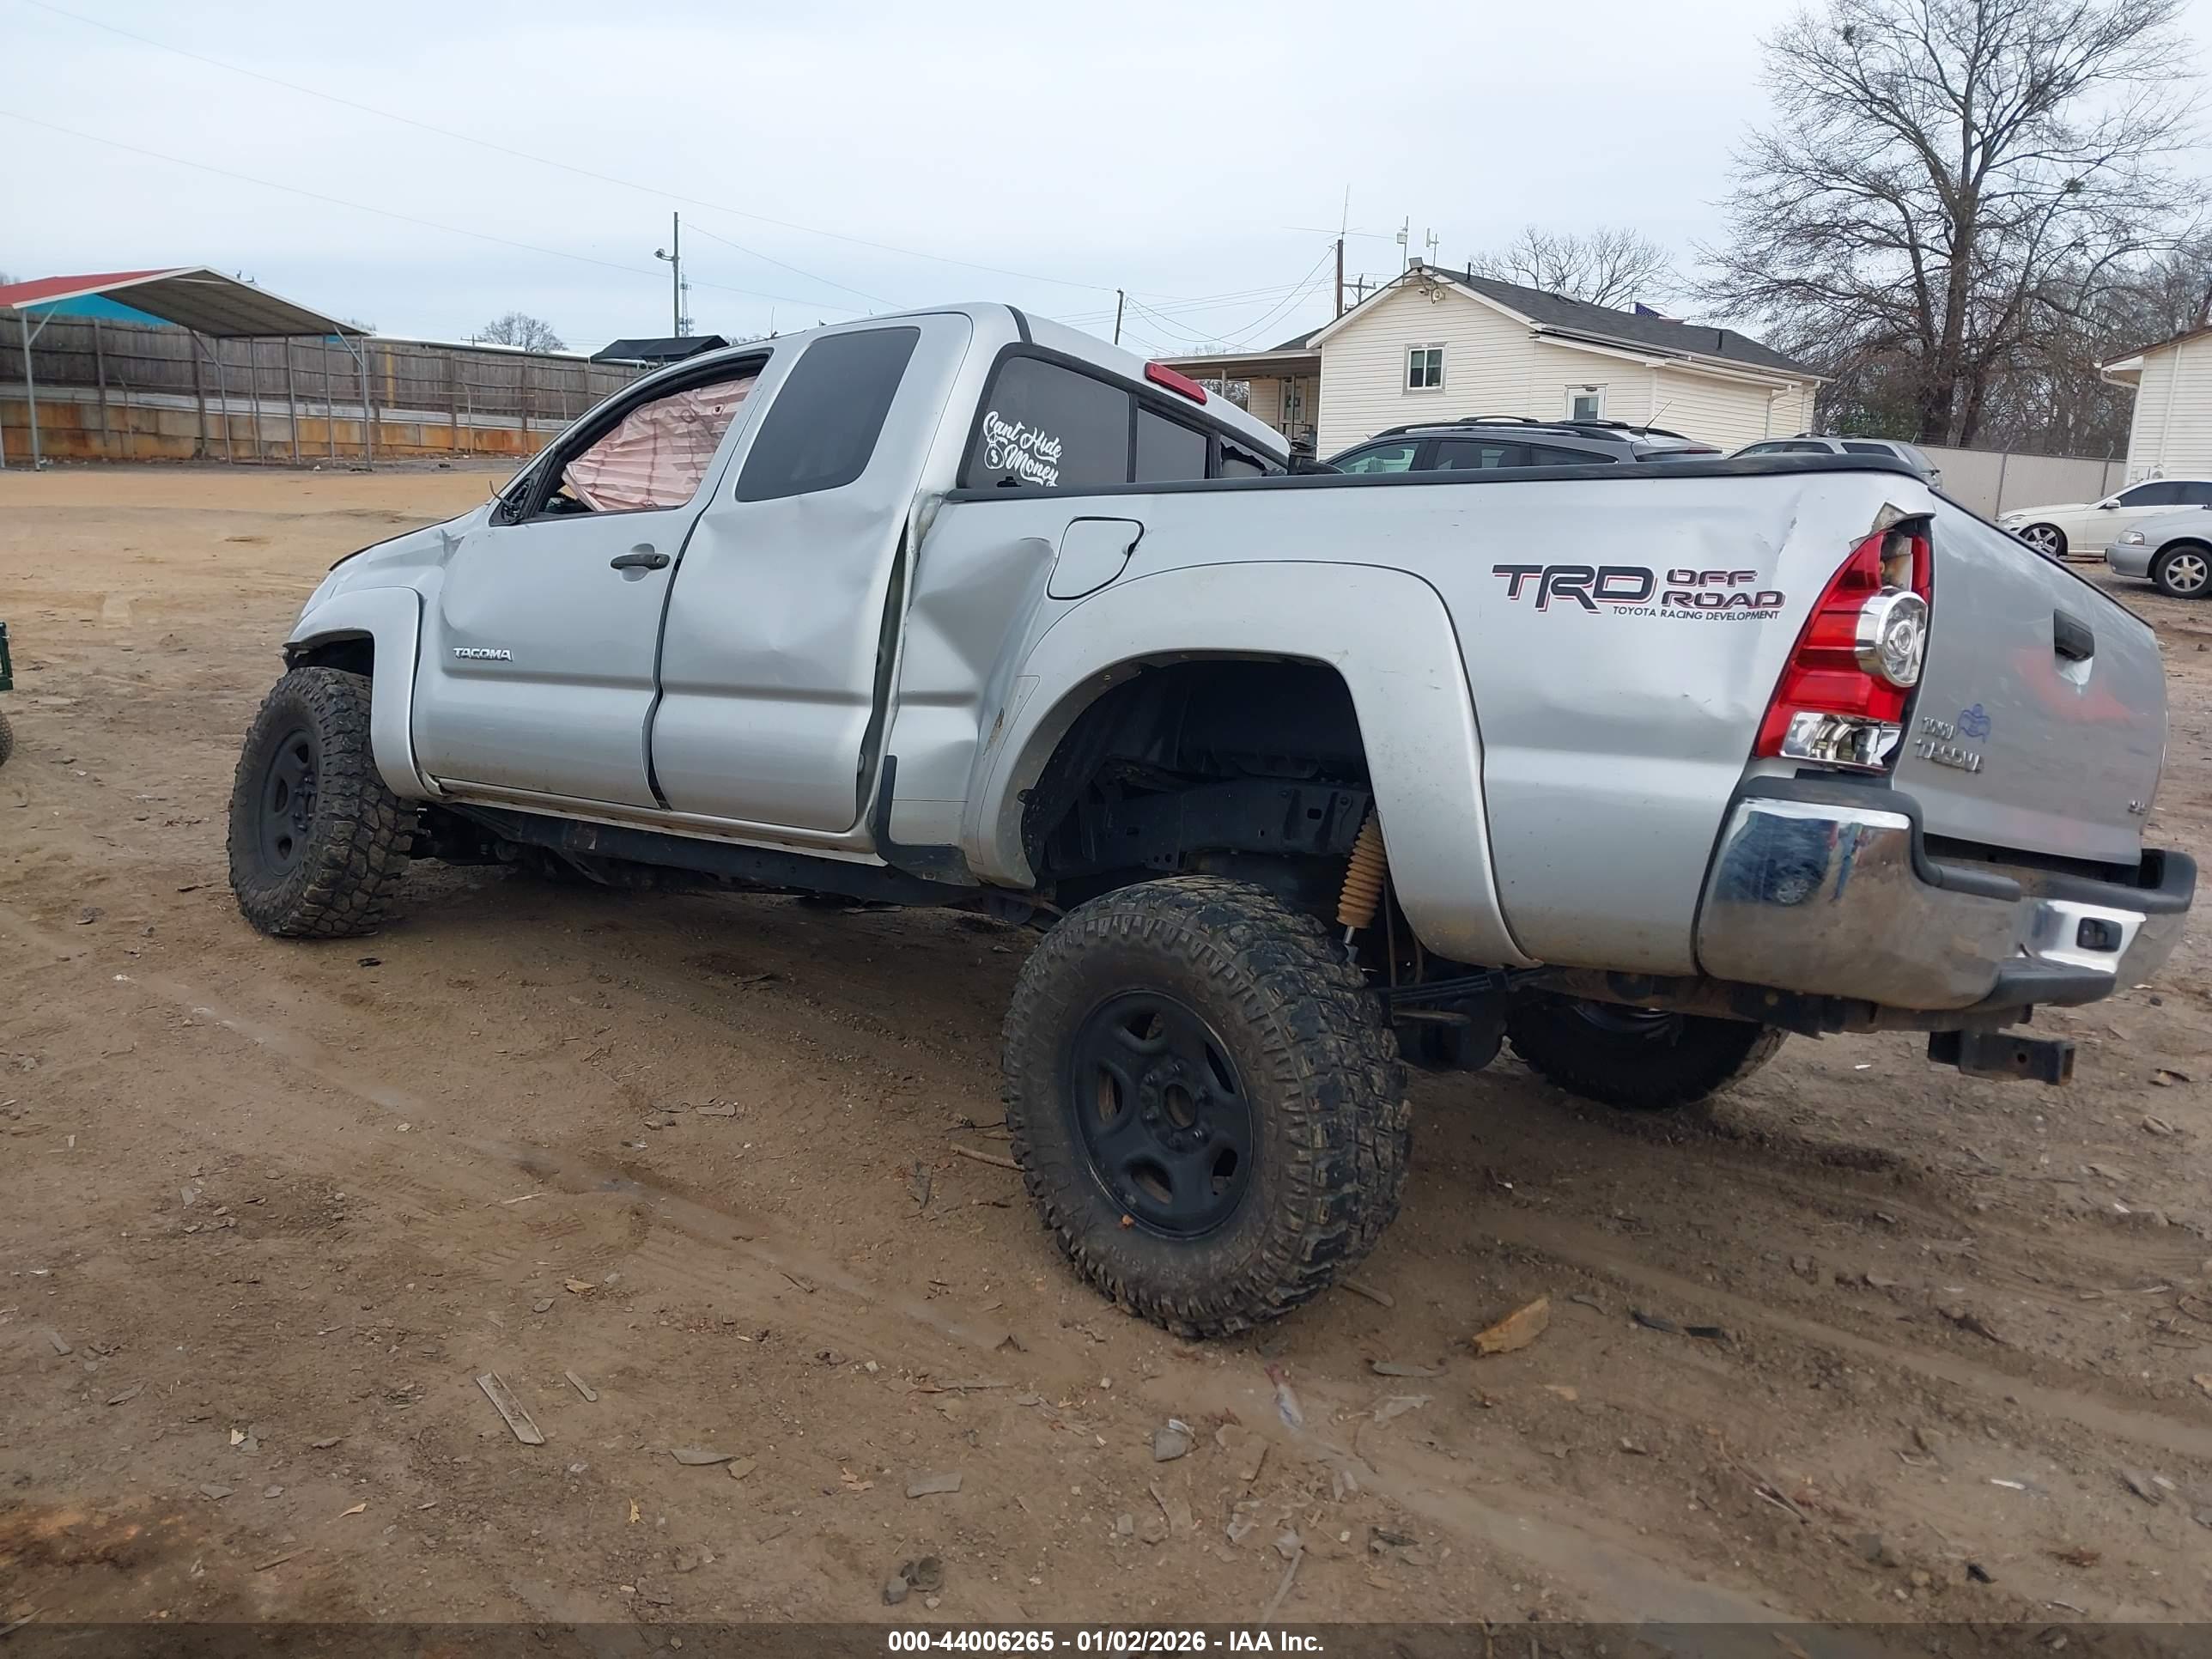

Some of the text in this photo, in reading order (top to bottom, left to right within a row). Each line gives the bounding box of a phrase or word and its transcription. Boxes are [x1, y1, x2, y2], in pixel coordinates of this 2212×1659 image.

[1019, 427, 1062, 465] Hide
[1003, 444, 1059, 487] Money
[1666, 568, 1759, 587] OFF
[1492, 564, 1658, 615] TRD
[1660, 590, 1786, 611] ROAD
[1613, 605, 1781, 622] TOYOTA RACING DEVELOPMENT
[453, 647, 514, 662] TACOMA
